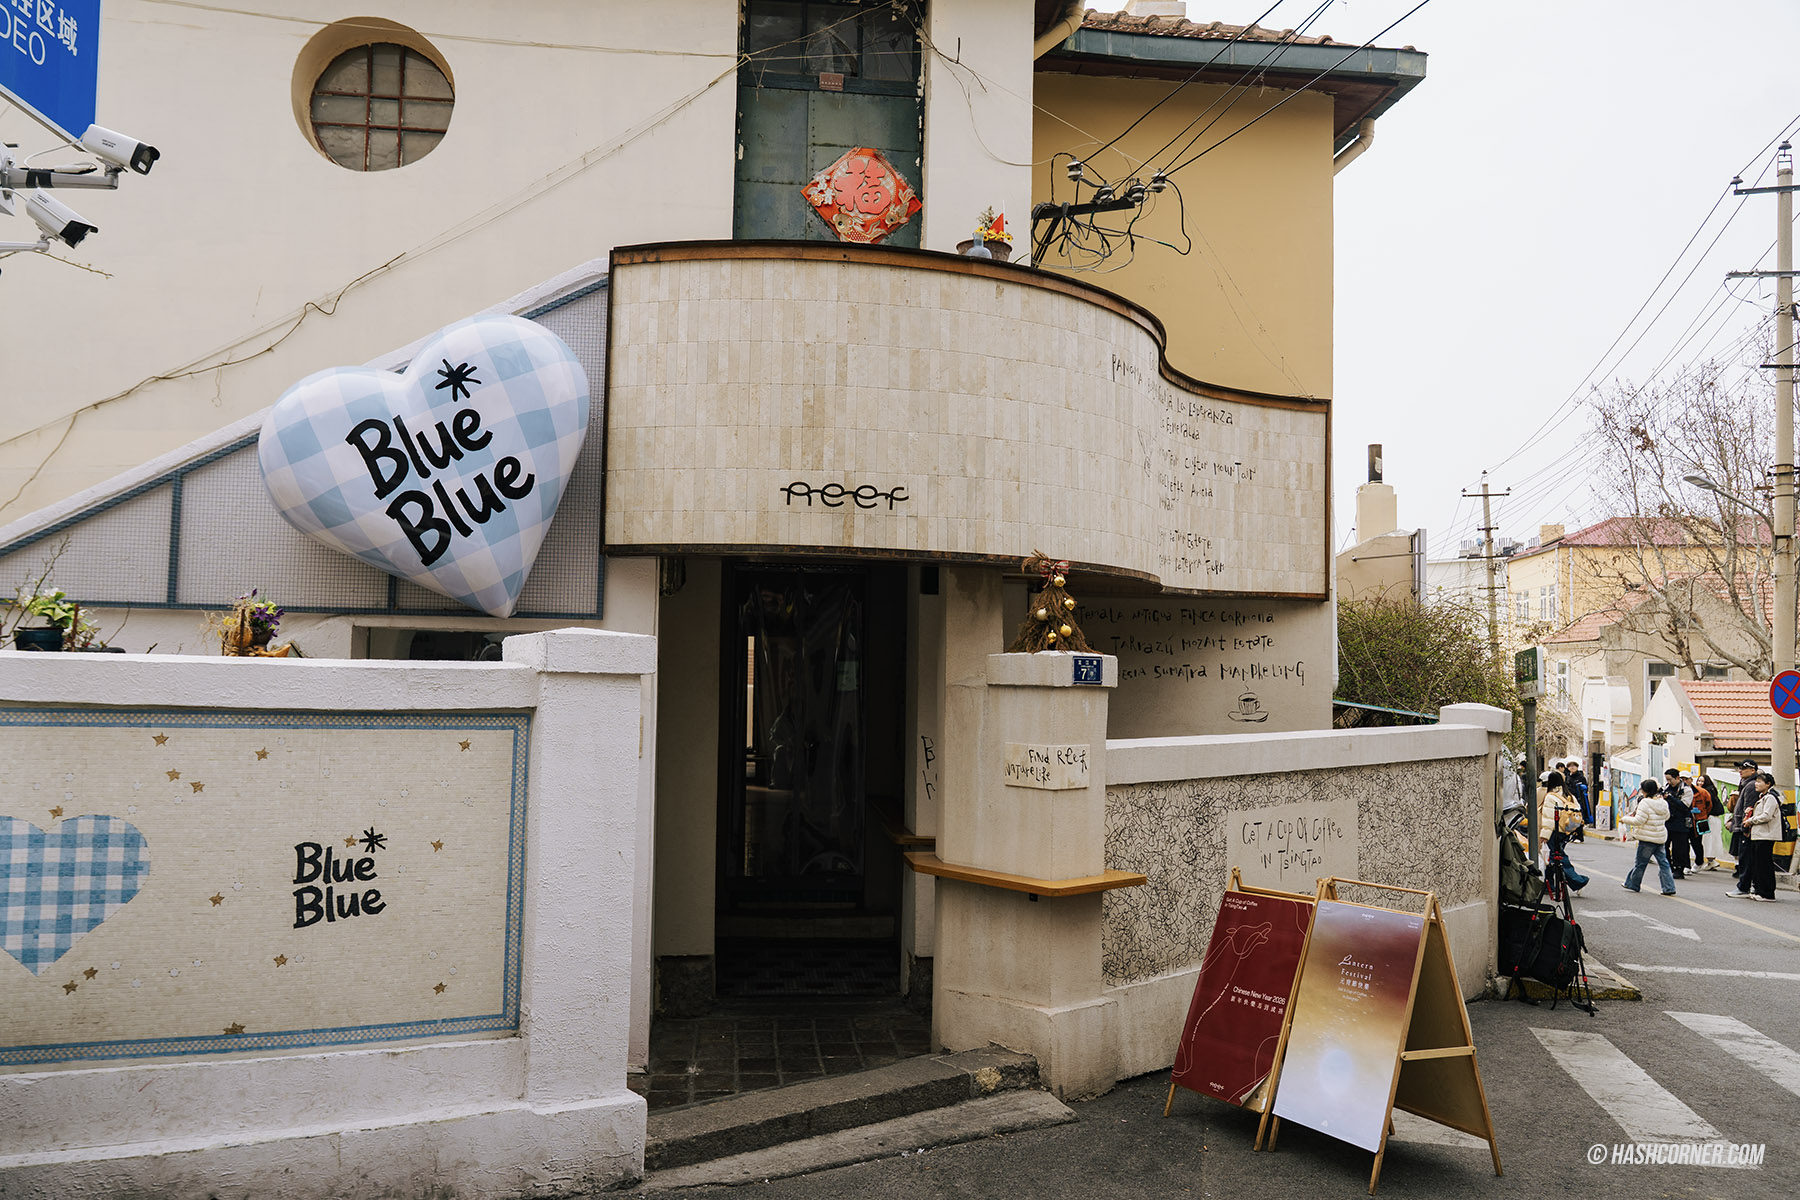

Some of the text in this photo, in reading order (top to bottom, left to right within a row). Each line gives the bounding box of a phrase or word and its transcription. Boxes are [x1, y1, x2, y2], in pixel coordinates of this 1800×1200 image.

[834, 159, 892, 215] 福
[345, 408, 494, 501] Blue
[385, 456, 536, 567] Blue
[293, 841, 378, 885] Blue
[292, 885, 388, 930] Blue
[1338, 954, 1374, 971] Lantern
[1341, 968, 1372, 981] Festival
[1232, 985, 1251, 997] Chinese
[1250, 990, 1262, 999] New
[1261, 993, 1273, 1001] Year
